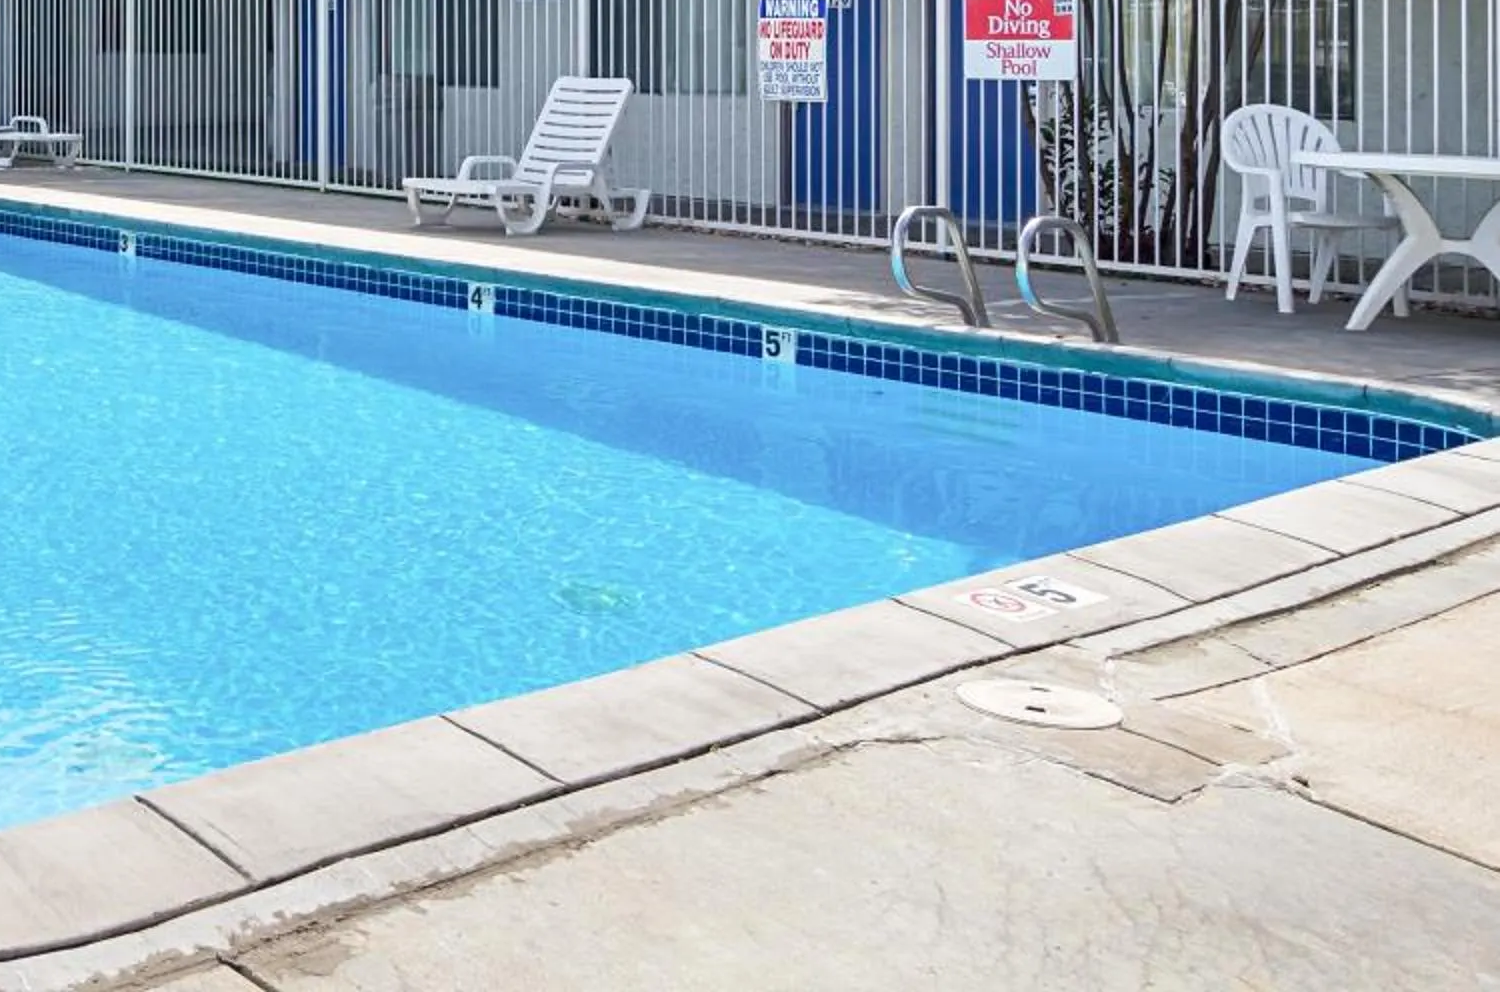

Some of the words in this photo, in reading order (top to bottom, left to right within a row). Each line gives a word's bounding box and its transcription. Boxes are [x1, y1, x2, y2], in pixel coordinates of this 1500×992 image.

[774, 20, 824, 39] LIFEGUARD
[987, 16, 1052, 39] Diving
[770, 41, 783, 60] ON
[785, 41, 811, 61] DUTY
[986, 41, 1052, 59] Shallow
[1001, 59, 1038, 77] Pool
[1017, 583, 1077, 603] 5
